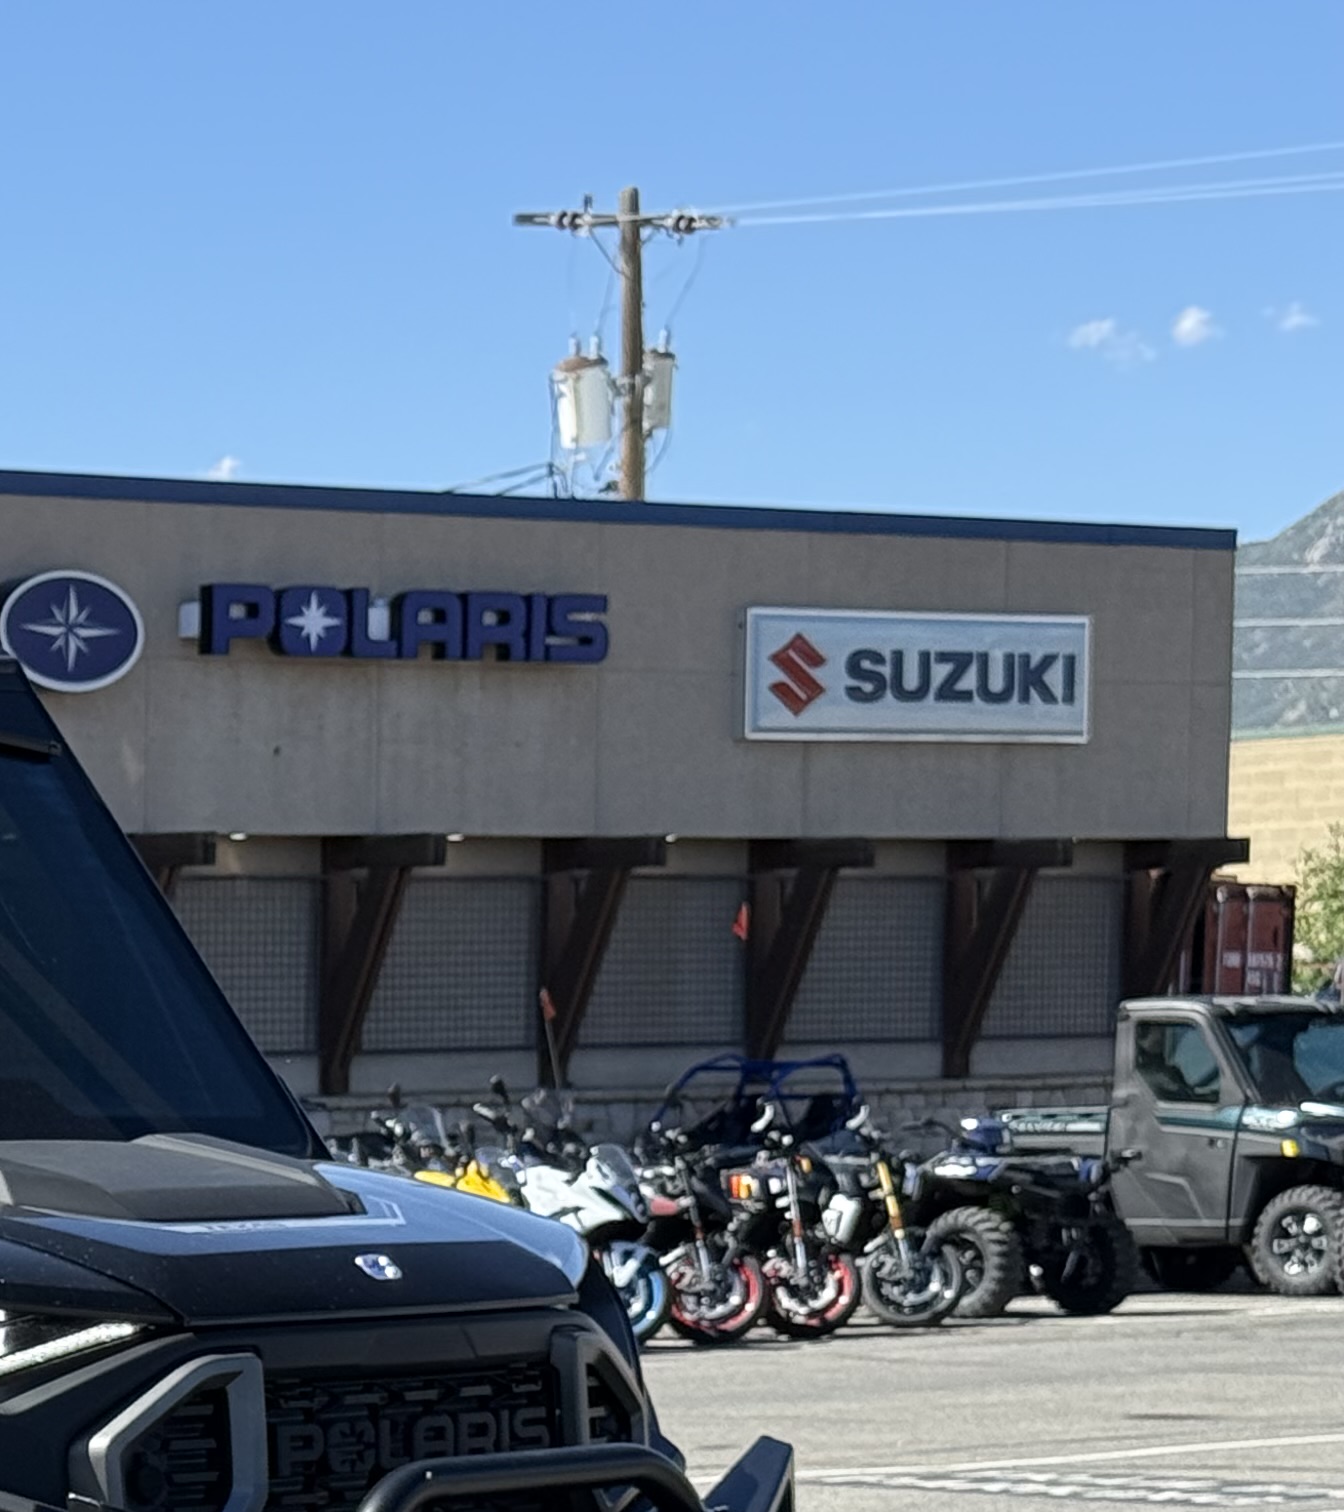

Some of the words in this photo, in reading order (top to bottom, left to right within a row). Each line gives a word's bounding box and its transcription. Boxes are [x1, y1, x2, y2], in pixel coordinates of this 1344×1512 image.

[202, 583, 609, 663] POLARIS
[844, 647, 1077, 706] SUZUKI
[277, 1406, 553, 1476] POLARIS
